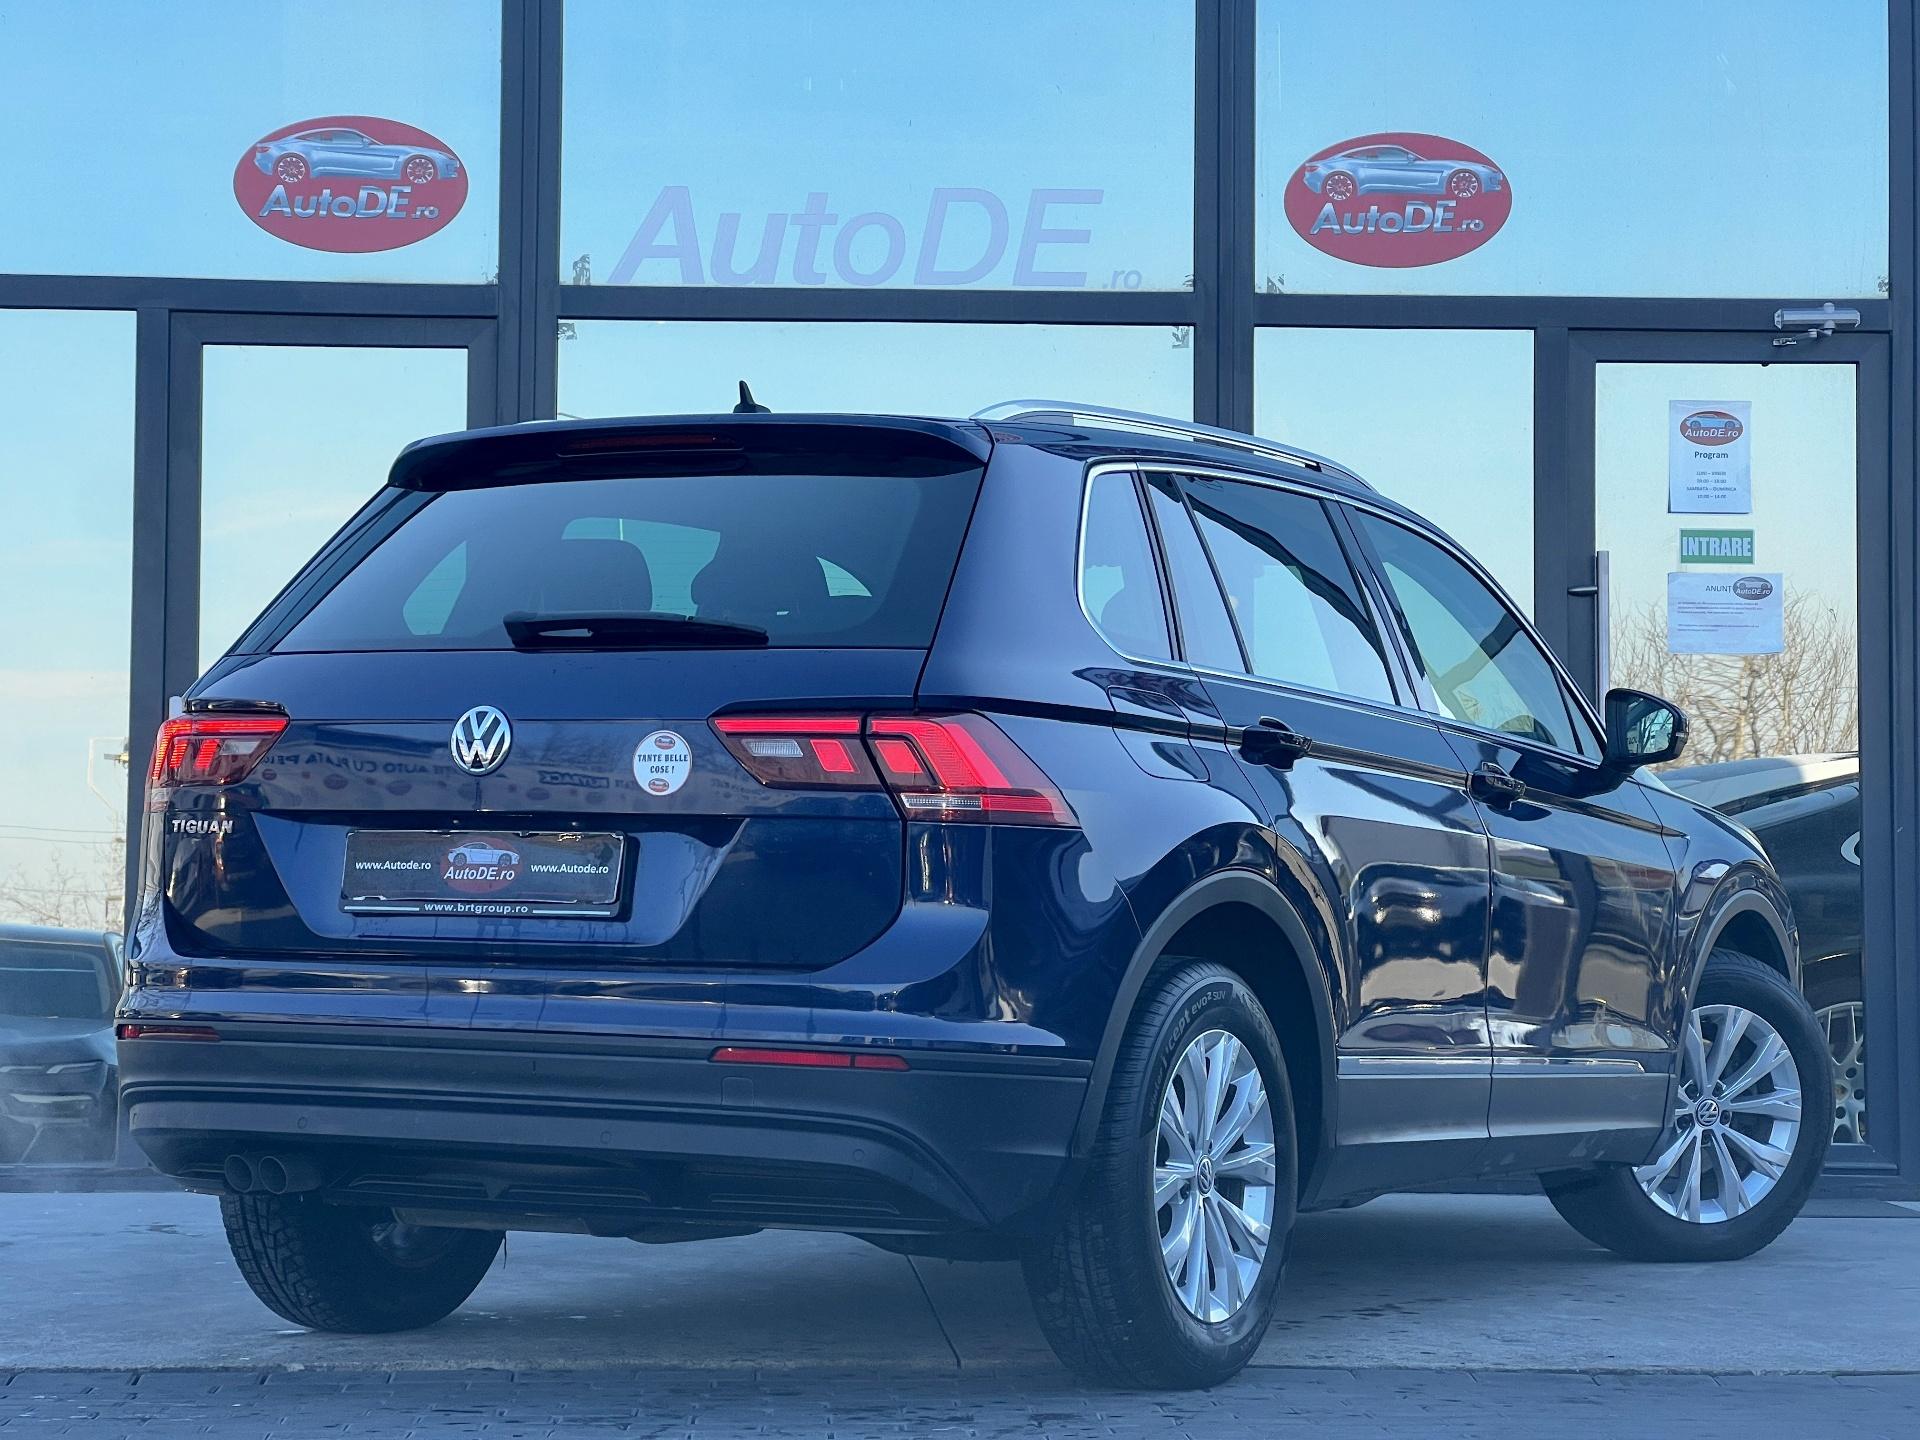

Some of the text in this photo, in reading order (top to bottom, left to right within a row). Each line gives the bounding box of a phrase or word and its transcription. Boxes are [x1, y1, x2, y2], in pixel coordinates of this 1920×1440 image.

[1685, 428, 1739, 438] AutoDE.ro
[1694, 451, 1729, 460] Program
[1682, 537, 1752, 557] INTRARE
[637, 754, 662, 763] TANTE
[172, 819, 233, 834] TIGUAN
[355, 860, 432, 871] www.Autode.ro
[530, 863, 609, 874] www.Autode.ro
[444, 866, 515, 881] AutoDE.ro
[424, 902, 529, 914] www.brtgroup.ro
[1213, 990, 1227, 1001] SUV
